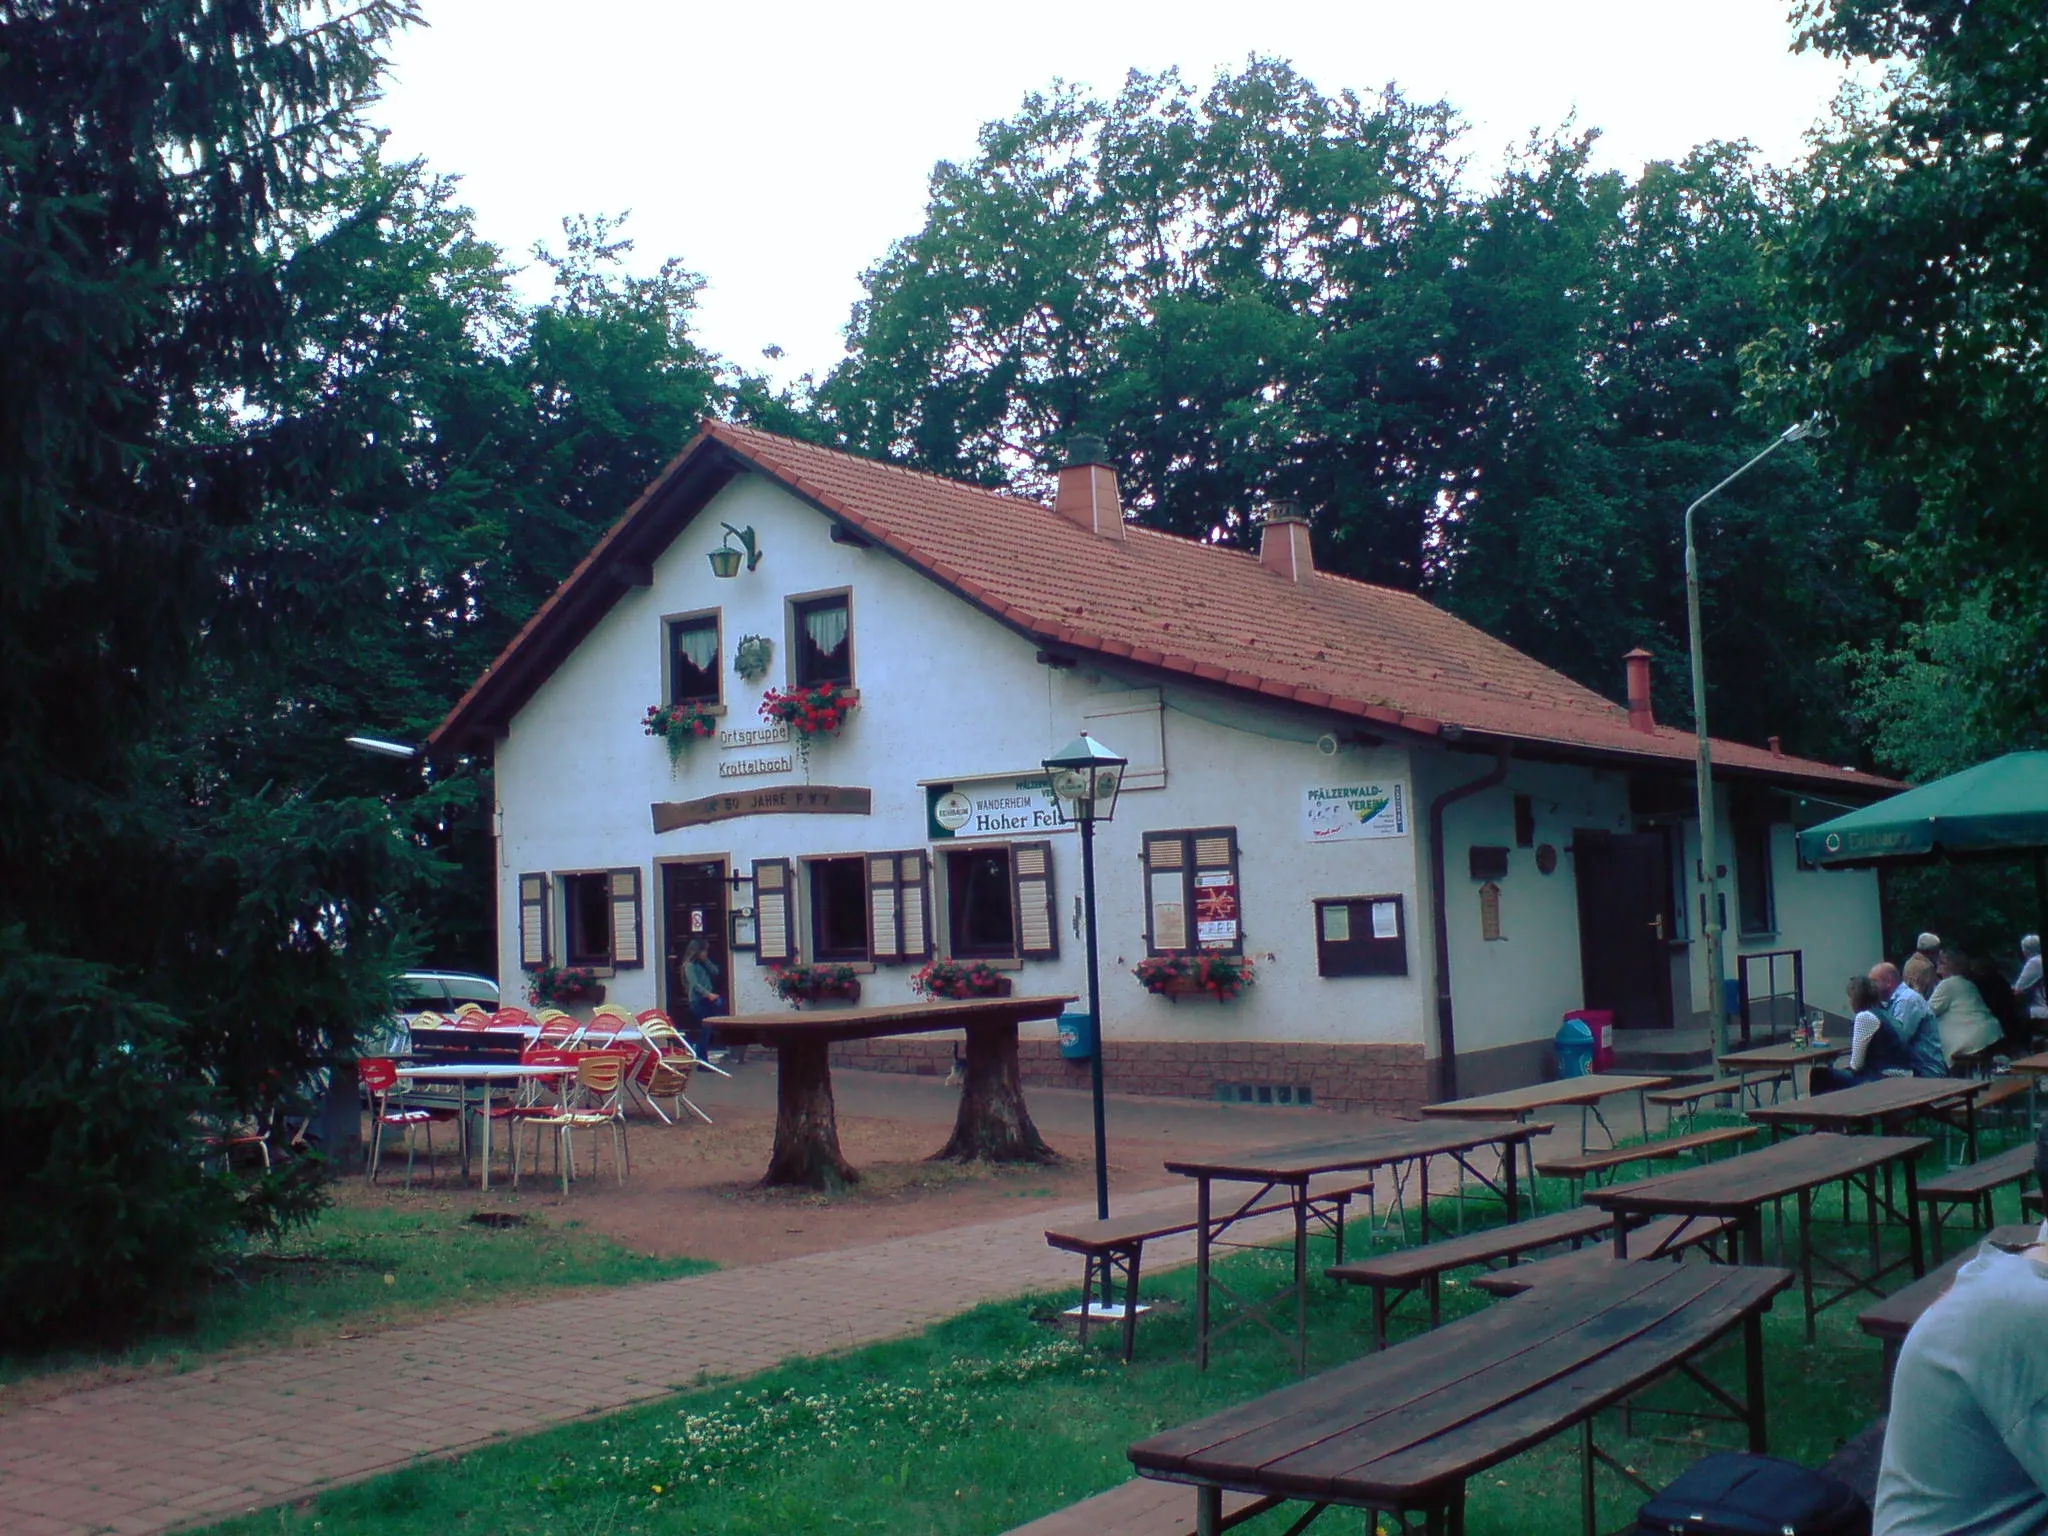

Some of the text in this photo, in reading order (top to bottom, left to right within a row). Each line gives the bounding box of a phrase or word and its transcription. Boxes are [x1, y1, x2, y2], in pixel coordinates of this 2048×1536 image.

[720, 727, 786, 744] Ortsgruppe
[719, 757, 789, 775] Krottelbach
[751, 793, 787, 808] JAHRE
[976, 796, 1031, 811] WANDERHEIM
[976, 813, 1028, 832] Hoher
